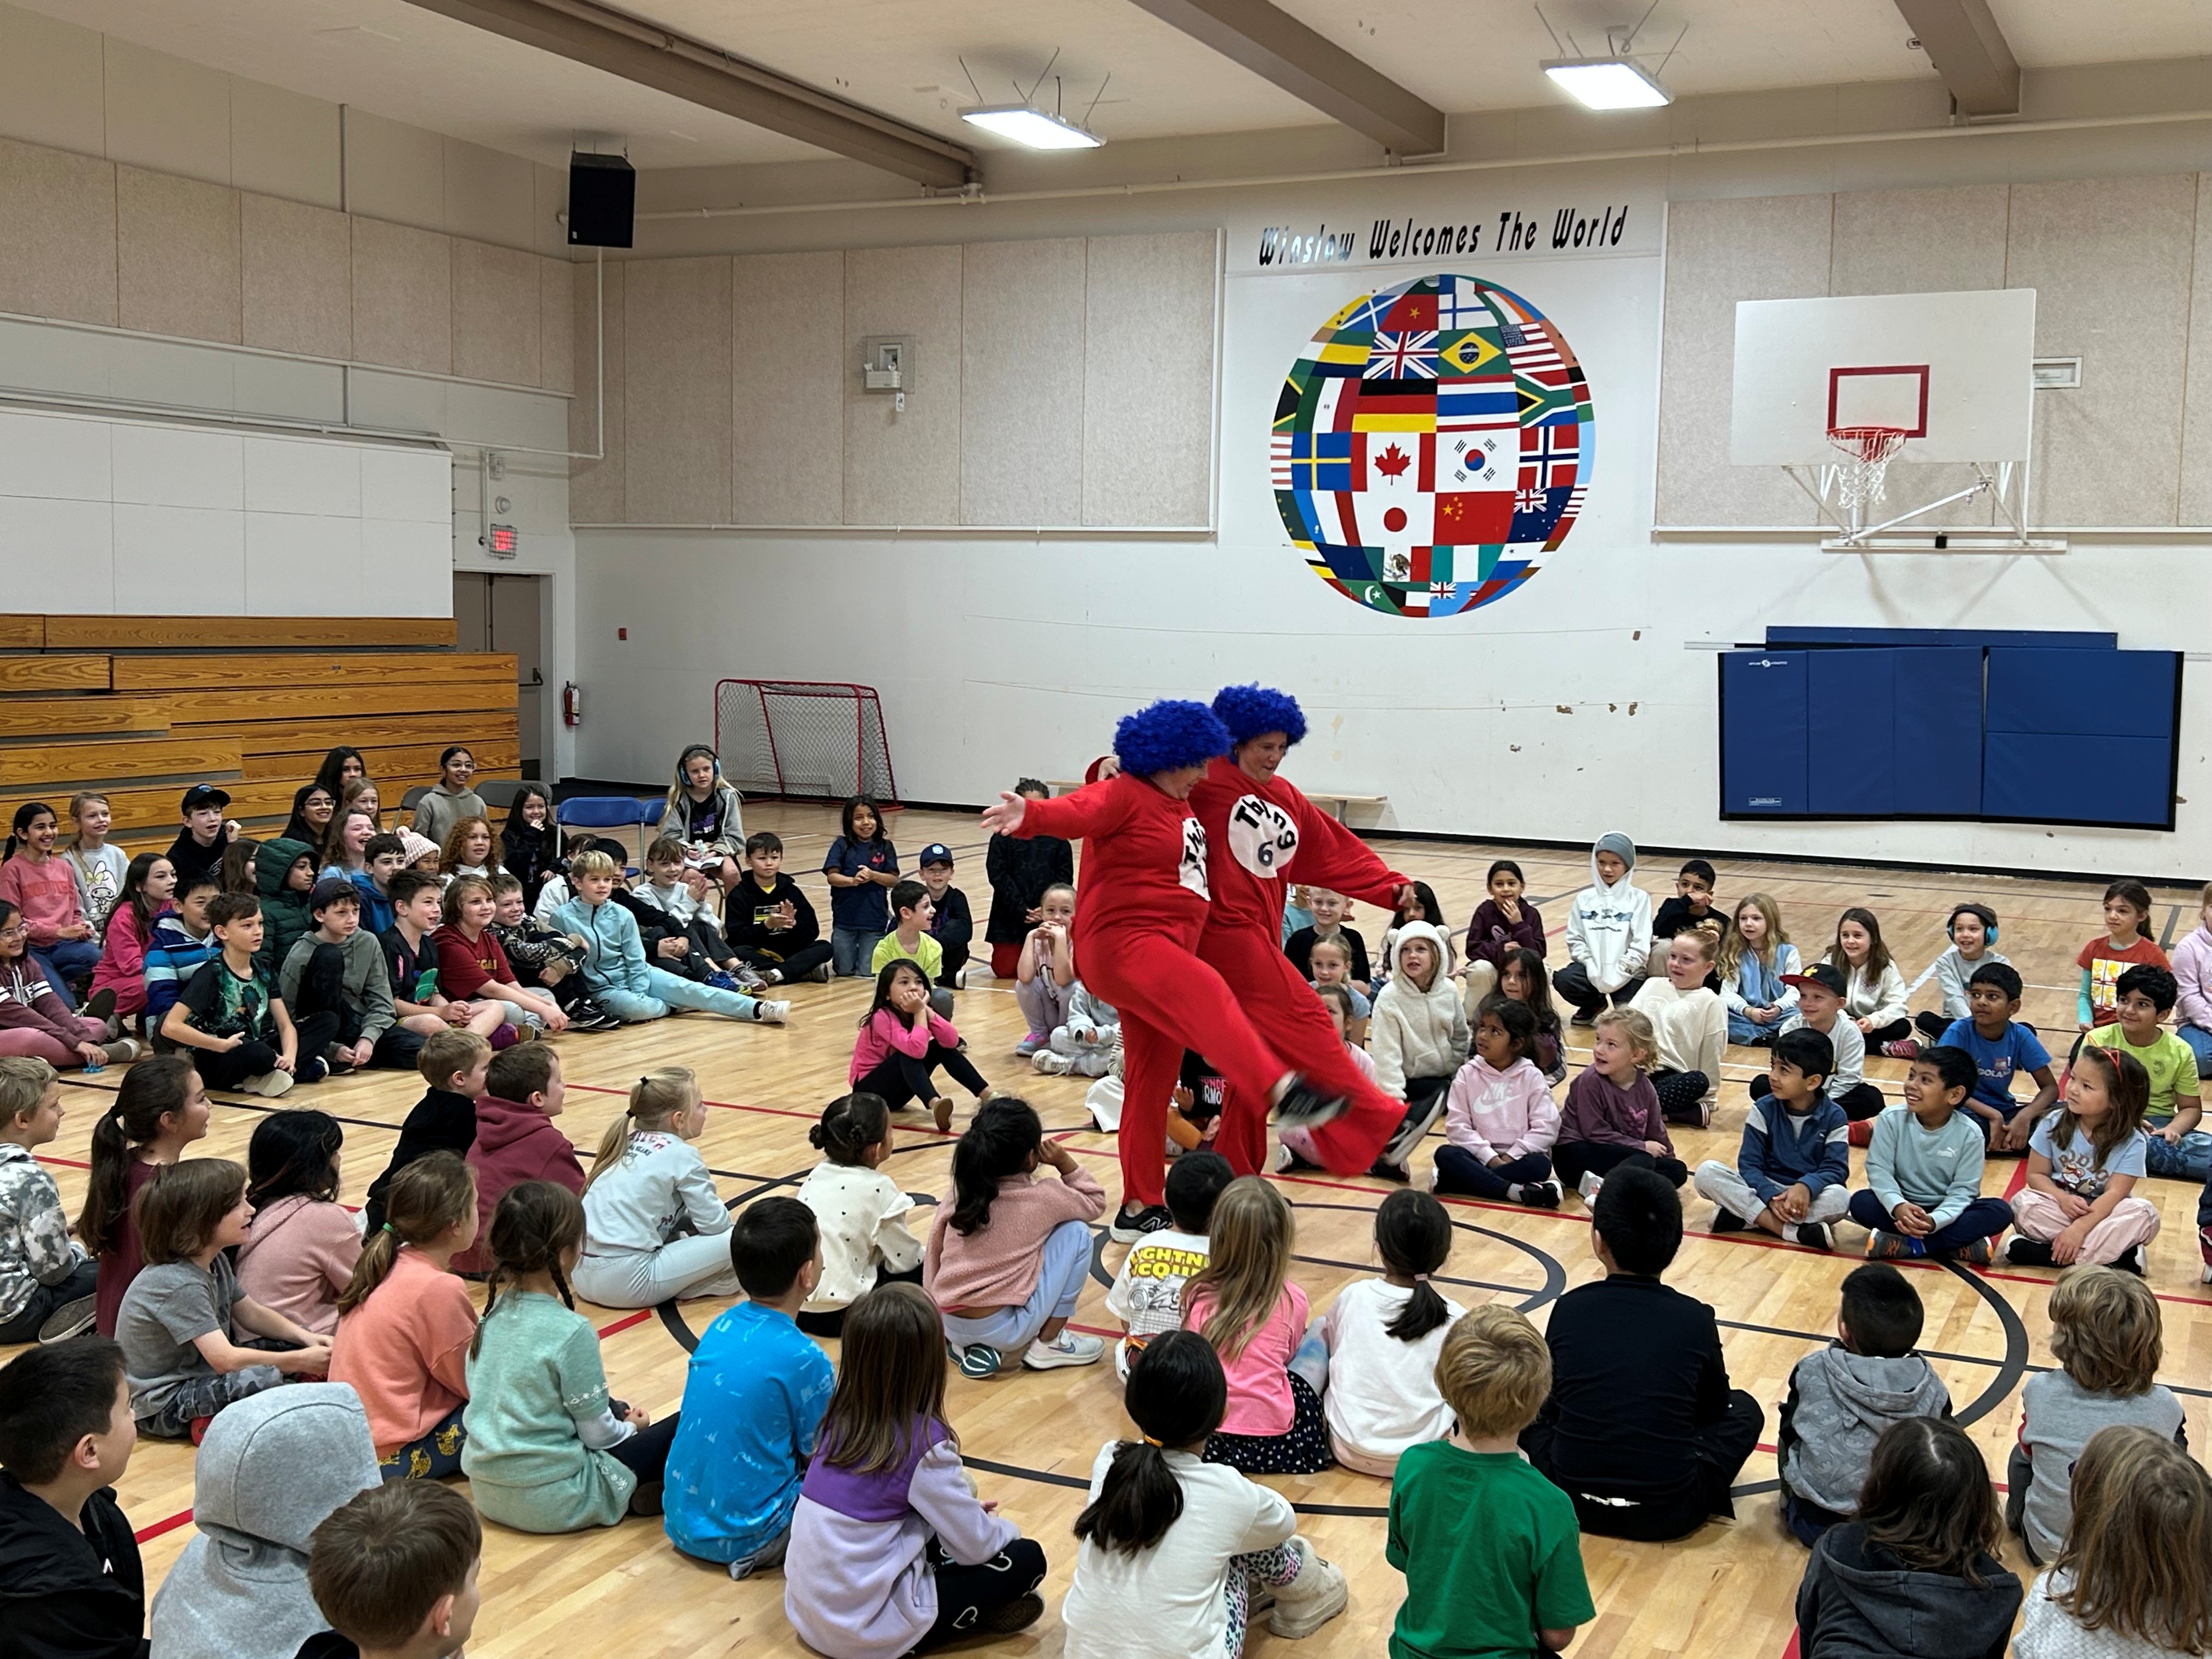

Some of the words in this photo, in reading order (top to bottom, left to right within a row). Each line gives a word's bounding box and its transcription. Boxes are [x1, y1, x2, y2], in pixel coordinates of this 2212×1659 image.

[1259, 224, 1355, 266] Winslow
[1369, 218, 1481, 259] Welcomes
[1496, 211, 1537, 251] The
[1552, 205, 1628, 249] World
[1258, 840, 1273, 866] 6
